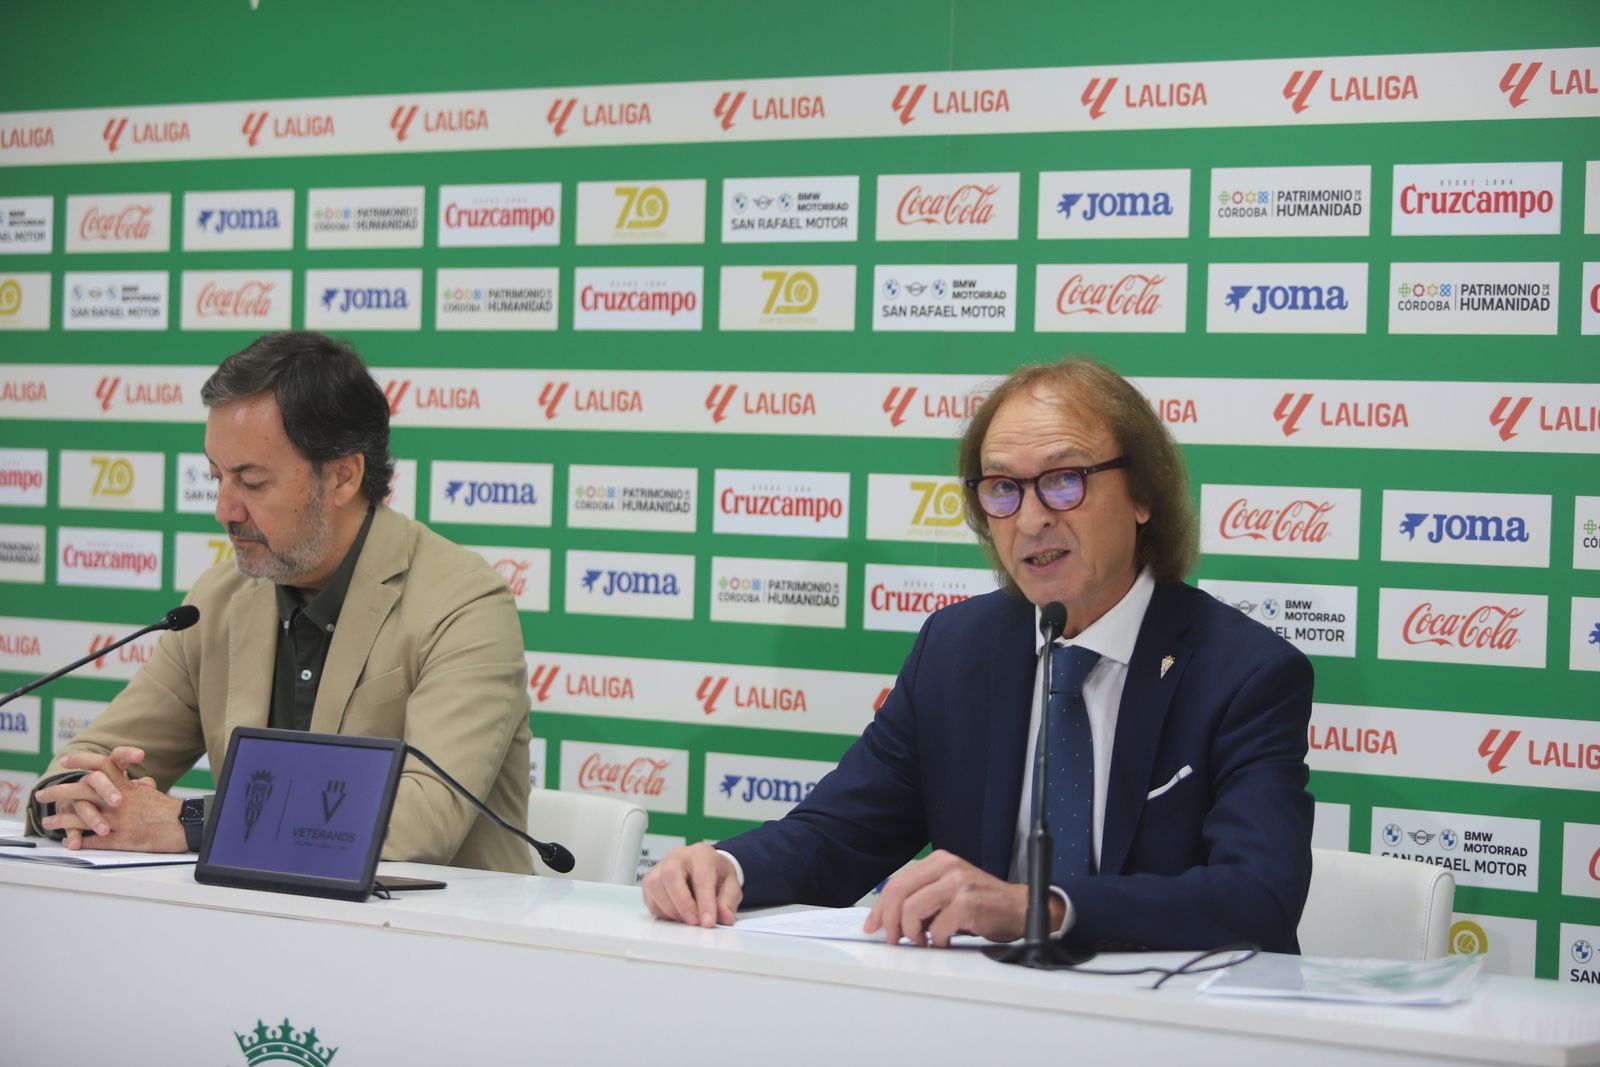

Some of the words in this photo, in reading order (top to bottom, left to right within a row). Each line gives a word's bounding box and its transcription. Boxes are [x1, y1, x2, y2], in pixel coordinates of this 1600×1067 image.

[1125, 82, 1208, 108] LALIGA
[1330, 75, 1419, 101] LALIGA
[752, 96, 825, 120] LALIGA
[933, 89, 1010, 114] LALIGA
[424, 110, 489, 133] LALIGA
[582, 102, 652, 126] LALIGA
[1, 127, 55, 148] LALIGA
[132, 121, 190, 143] LALIGA
[273, 115, 335, 138] LALIGA
[797, 193, 821, 201] BMW
[896, 184, 1000, 225] Coca-Cola
[1277, 190, 1352, 203] PATRIMONIO
[1400, 184, 1554, 219] Cruzcampo
[445, 200, 555, 231] Cruzcampo
[614, 187, 669, 229] 70
[1218, 204, 1268, 218] CÓRDOBA
[1276, 203, 1362, 217] HUMANIDAD
[731, 219, 756, 231] SAN
[758, 217, 803, 230] RAFAEL
[806, 217, 848, 230] MOTOR
[762, 271, 818, 314] 70
[952, 280, 977, 289] BMW
[952, 290, 1006, 300] MOTORRAD
[1056, 273, 1166, 316] Coca-Cola
[1461, 284, 1540, 296] PATRIMONIO
[488, 301, 552, 312] HUMANIDAD
[581, 285, 697, 315] Cruzcampo
[882, 305, 907, 318] SAN
[910, 304, 957, 318] RAFAEL
[961, 304, 1006, 318] MOTOR
[1398, 299, 1450, 312] CÓRDOBA
[1460, 298, 1550, 311] HUMANIDAD
[125, 384, 183, 405] LALIGA
[416, 387, 480, 409] LALIGA
[574, 389, 643, 413] LALIGA
[743, 392, 816, 416] LALIGA
[1320, 402, 1408, 427] LALIGA
[1540, 406, 1600, 432] LALI
[622, 487, 682, 500] PATRIMONIO
[721, 486, 843, 522] Cruzcampo
[622, 501, 690, 513] HUMANIDAD
[1219, 498, 1336, 544] Coca-Cola
[63, 543, 157, 574] Cruzcampo
[768, 579, 832, 593] PATRIMONIO
[768, 592, 840, 608] HUMANIDAD
[871, 582, 969, 613] Cruzca
[1285, 600, 1312, 610] BMW
[1284, 612, 1346, 623] MOTORRAD
[1403, 602, 1526, 651] Coca-Cola
[1295, 628, 1345, 642] MOTOR
[566, 673, 634, 700] LALIGA
[734, 685, 808, 712] LALIGA
[1309, 725, 1398, 755] LALIGA
[293, 826, 356, 843] VETERANOS
[1464, 831, 1493, 842] BMW
[1464, 843, 1528, 857] MOTORRAD
[1474, 860, 1527, 877] MOTOR
